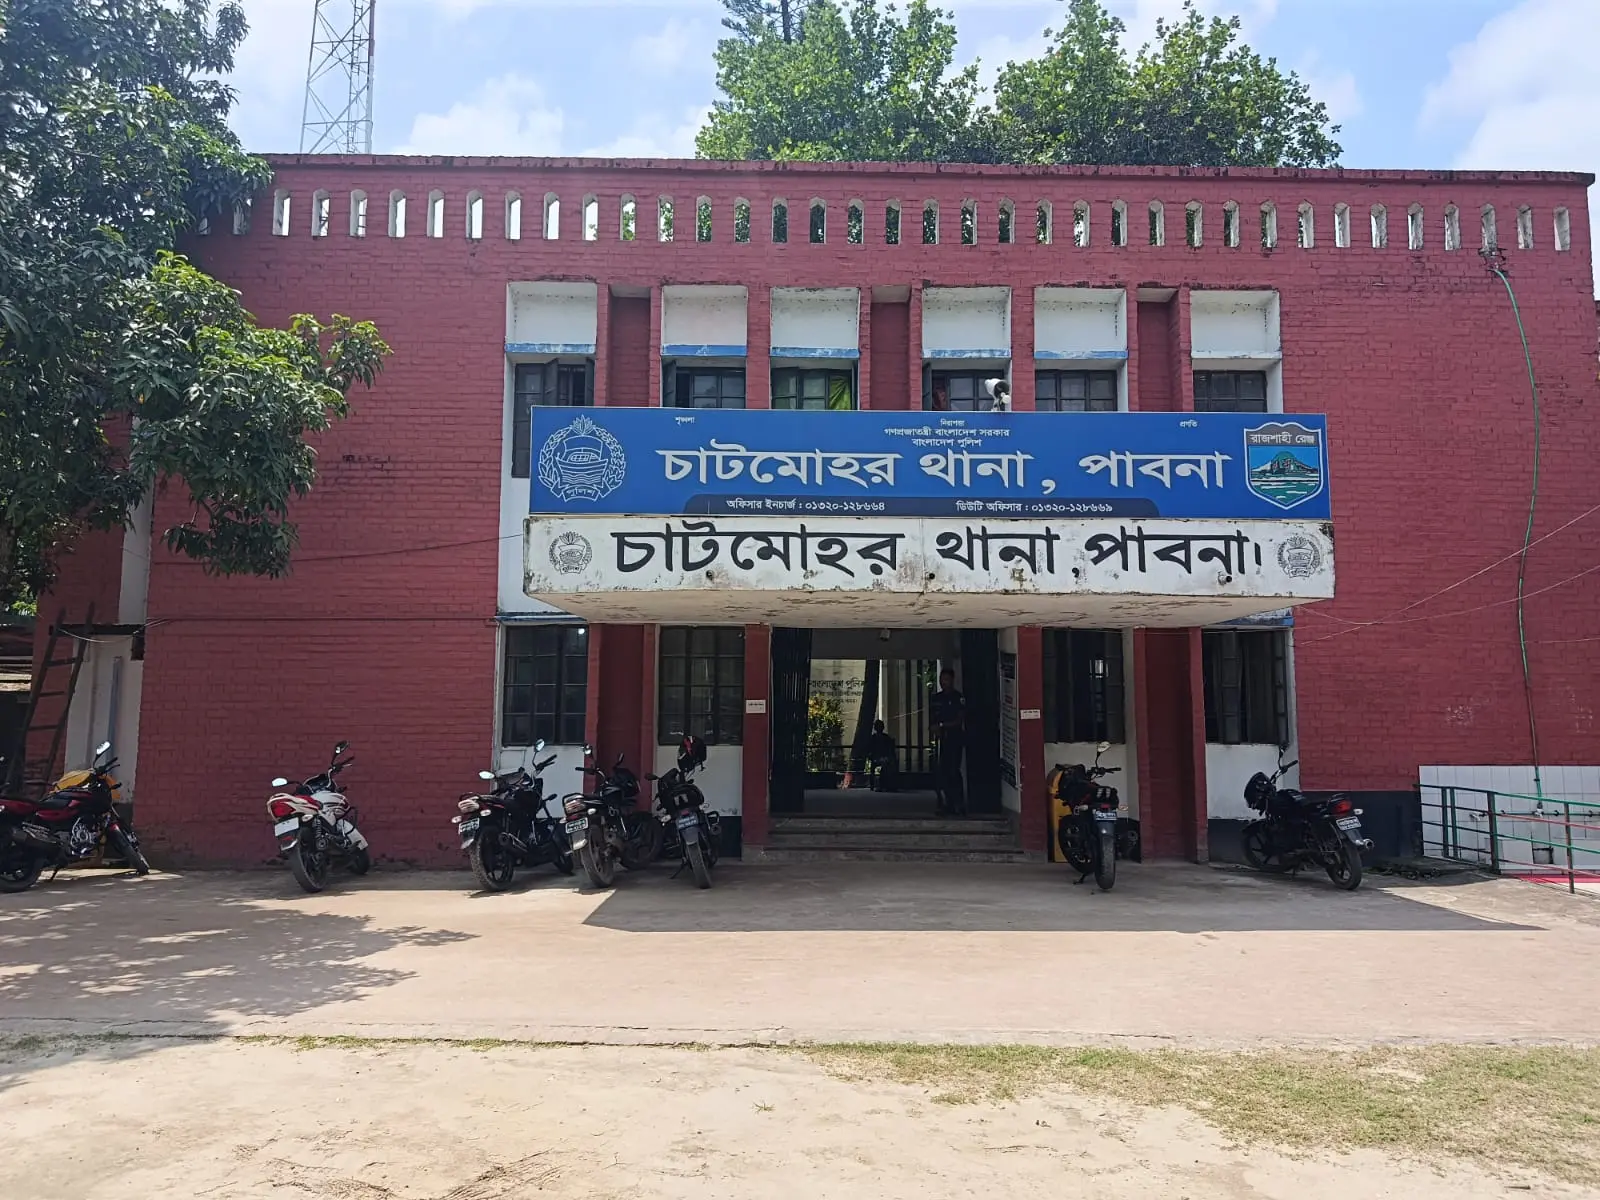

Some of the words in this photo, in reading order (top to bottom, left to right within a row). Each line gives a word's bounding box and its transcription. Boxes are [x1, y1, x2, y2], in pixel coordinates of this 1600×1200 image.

[935, 428, 976, 437] বাংলাদেশ
[979, 428, 1010, 437] সরকার
[1249, 432, 1293, 444] রাজশাহী
[911, 438, 954, 448] বাংলাদেশ
[956, 437, 982, 448] পুলিশ
[655, 438, 904, 488] চাটমোহর
[1078, 450, 1232, 489] পাবনা
[726, 497, 763, 509] অফিসার
[765, 497, 797, 510] ইনচার্জ
[805, 501, 886, 511] ০১৩২০-১২৮৬৬৪
[955, 500, 984, 512] ডিউটি
[986, 500, 1023, 512] অফিসার
[610, 520, 906, 578] চাটমোহর
